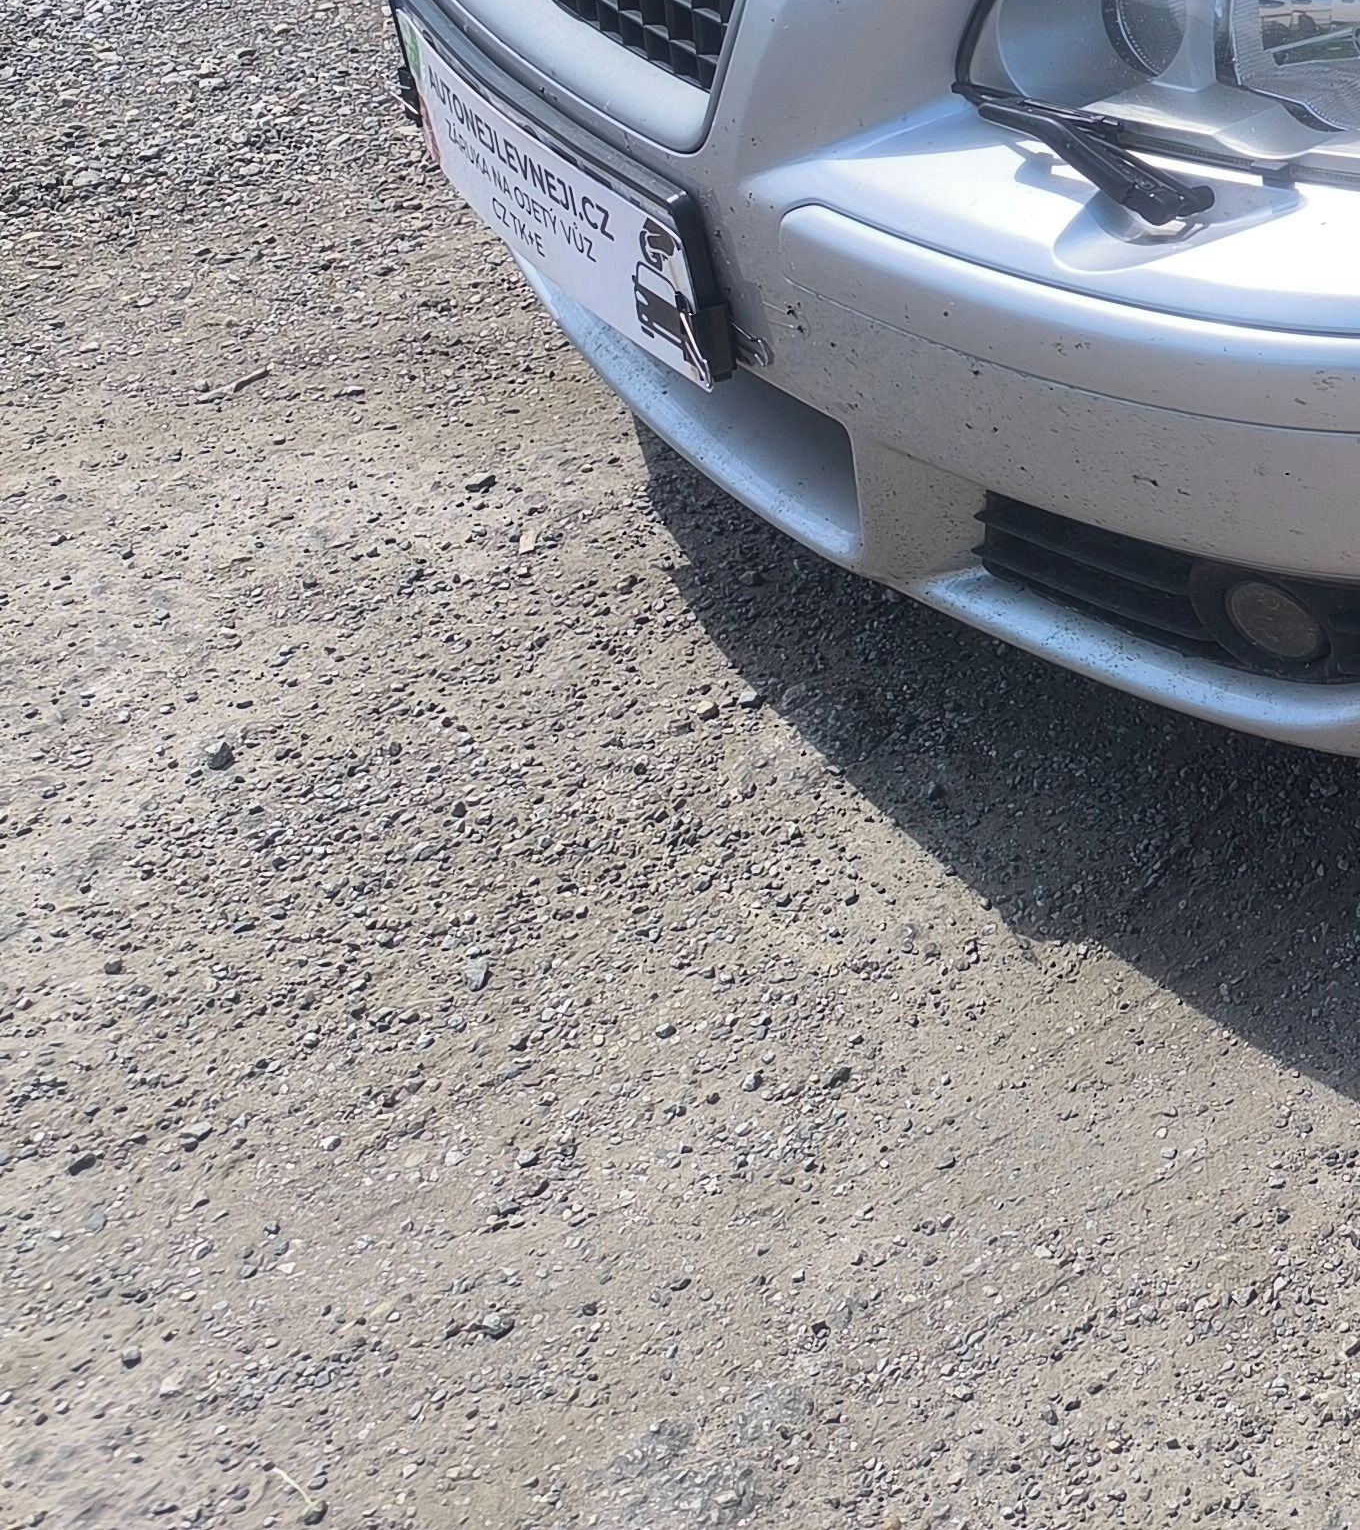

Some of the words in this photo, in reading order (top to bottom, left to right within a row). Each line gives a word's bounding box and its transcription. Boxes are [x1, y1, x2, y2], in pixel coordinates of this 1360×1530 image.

[428, 64, 615, 242] AUTONEJLEVNEJI.CZ
[492, 197, 511, 228] CZ
[492, 165, 514, 201] NA
[513, 186, 557, 235] OJETÝ
[560, 219, 597, 263] VŮZ
